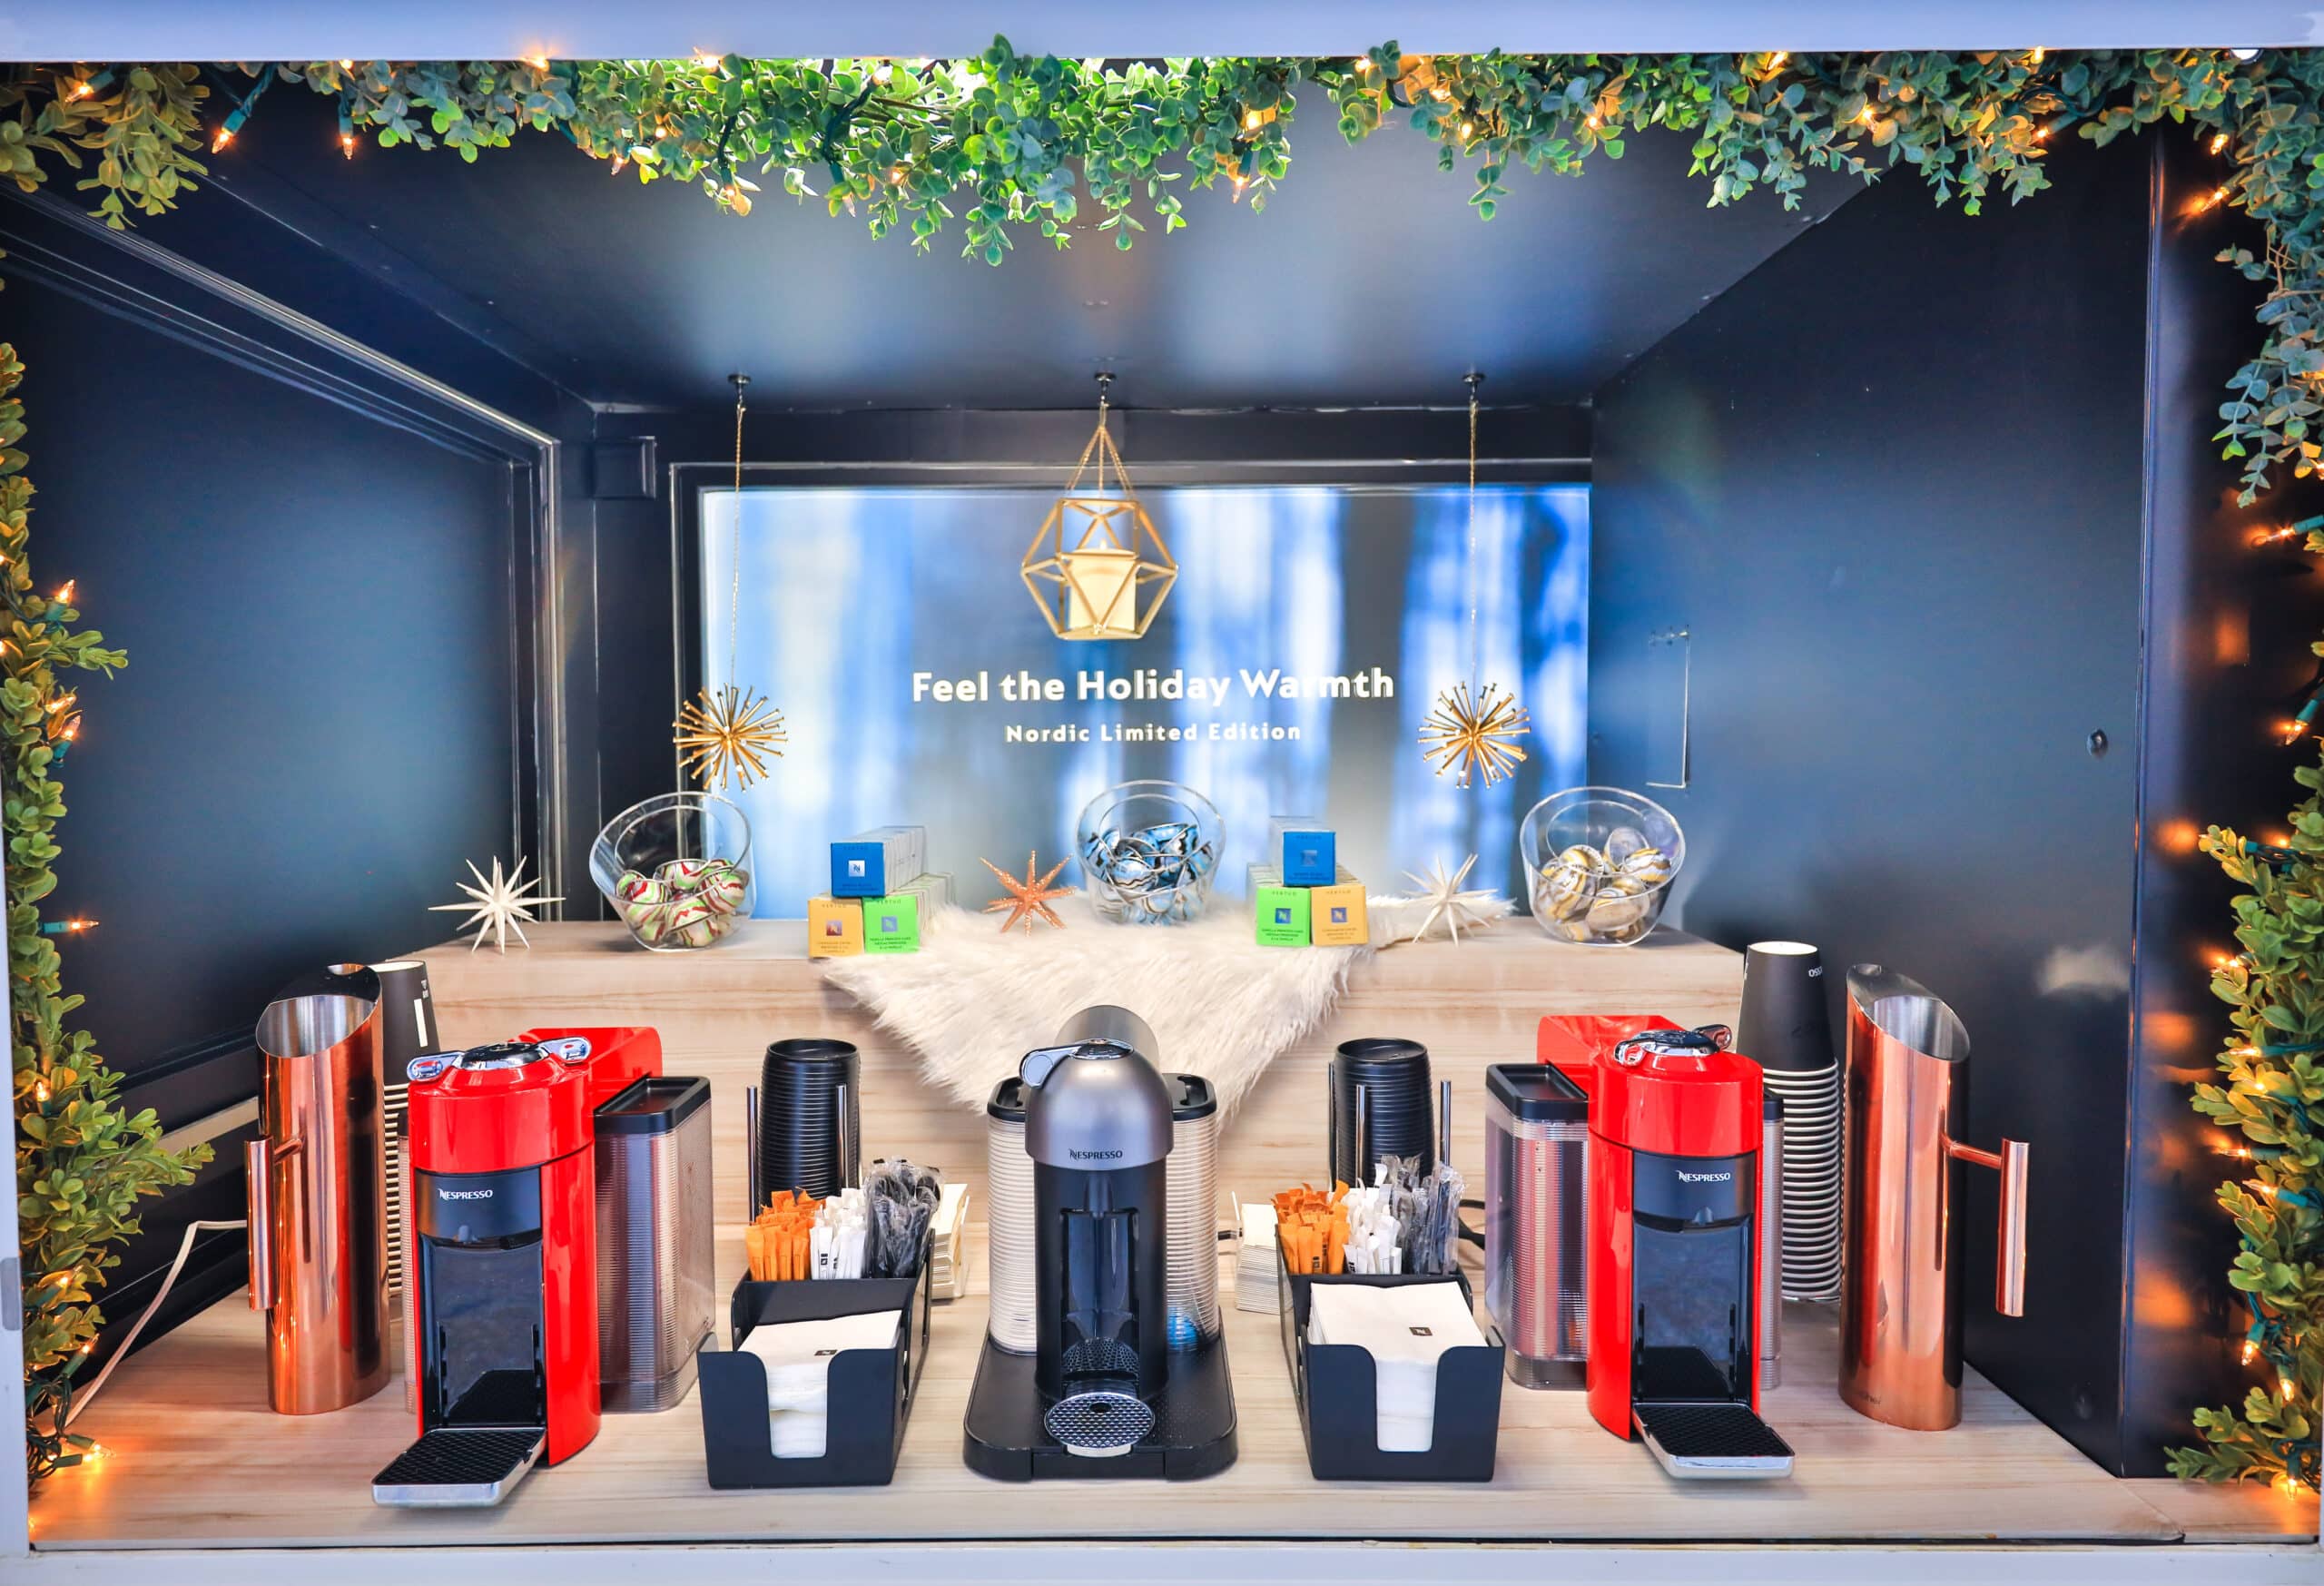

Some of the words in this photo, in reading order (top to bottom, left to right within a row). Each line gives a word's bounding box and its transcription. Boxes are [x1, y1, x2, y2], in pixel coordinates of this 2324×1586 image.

[912, 671, 990, 703] Feel
[1000, 670, 1065, 702] the
[1077, 669, 1231, 707] Holiday
[1239, 667, 1394, 699] Warmth
[1006, 724, 1090, 744] Nordic
[1100, 723, 1198, 743] Limited
[1208, 722, 1302, 742] Edition
[1068, 1148, 1123, 1160] NESPRESSO
[1675, 1169, 1731, 1183] NESPRESSO
[438, 1187, 494, 1201] NESPRESSO
